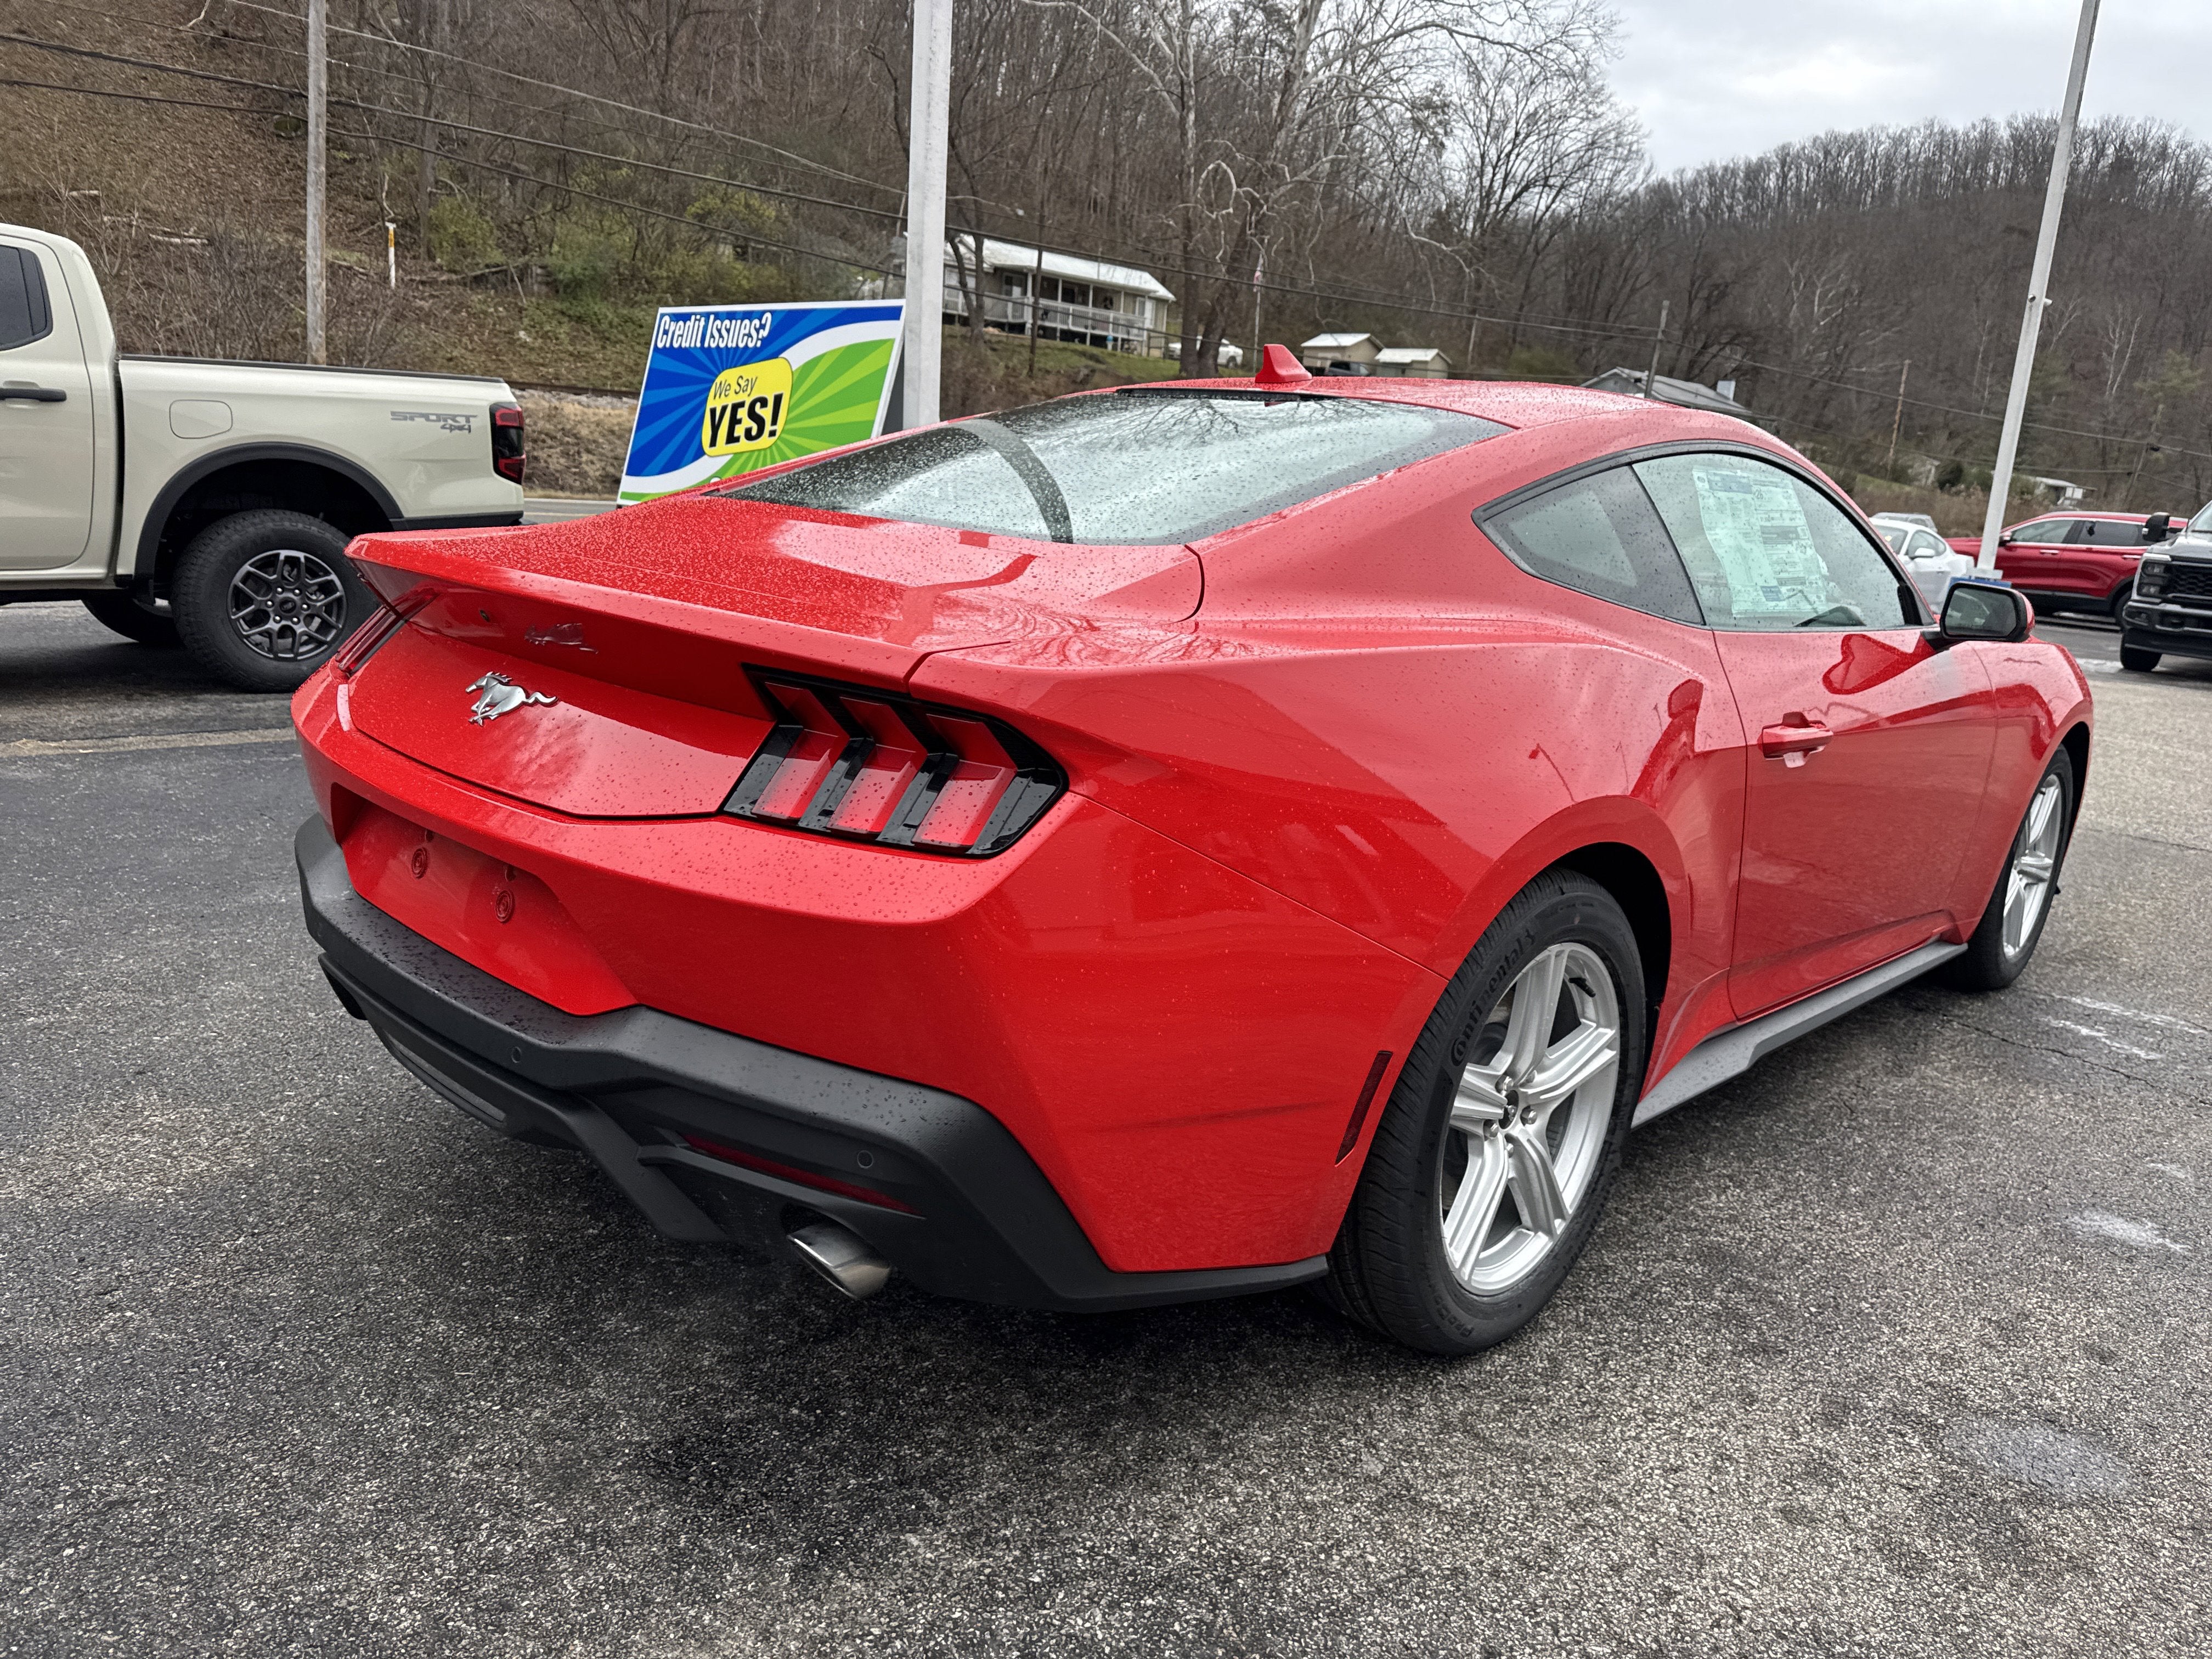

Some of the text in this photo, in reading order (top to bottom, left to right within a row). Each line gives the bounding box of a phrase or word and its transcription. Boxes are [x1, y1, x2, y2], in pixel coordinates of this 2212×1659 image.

[656, 312, 772, 348] Credit Issues?
[713, 375, 758, 400] We Say
[390, 411, 477, 424] SPORT
[708, 393, 783, 449] YES!
